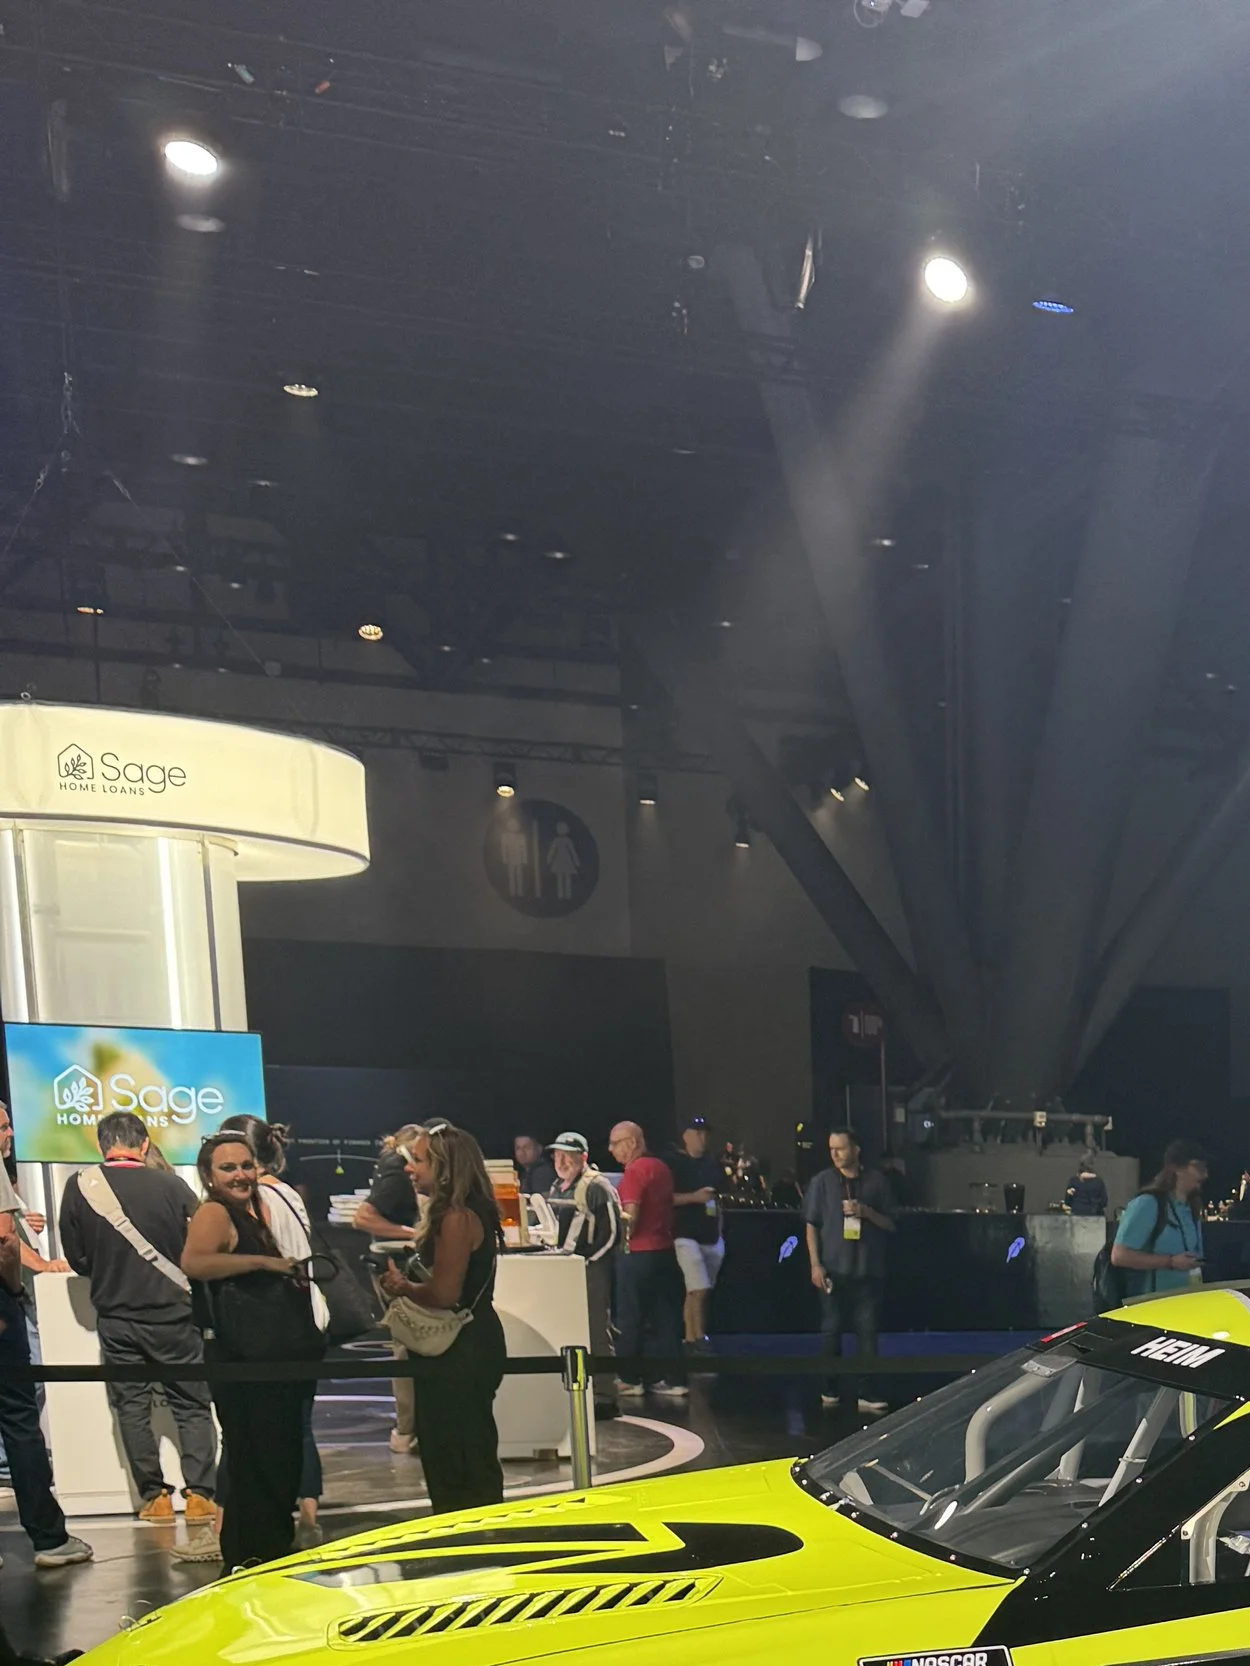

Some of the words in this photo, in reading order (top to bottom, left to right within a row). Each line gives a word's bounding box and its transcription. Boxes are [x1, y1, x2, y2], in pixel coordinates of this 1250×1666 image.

[60, 782, 97, 793] HOME
[102, 784, 145, 796] LOANS
[101, 752, 187, 794] Sage
[109, 1073, 225, 1125] Sage
[1130, 1336, 1226, 1369] HEIM
